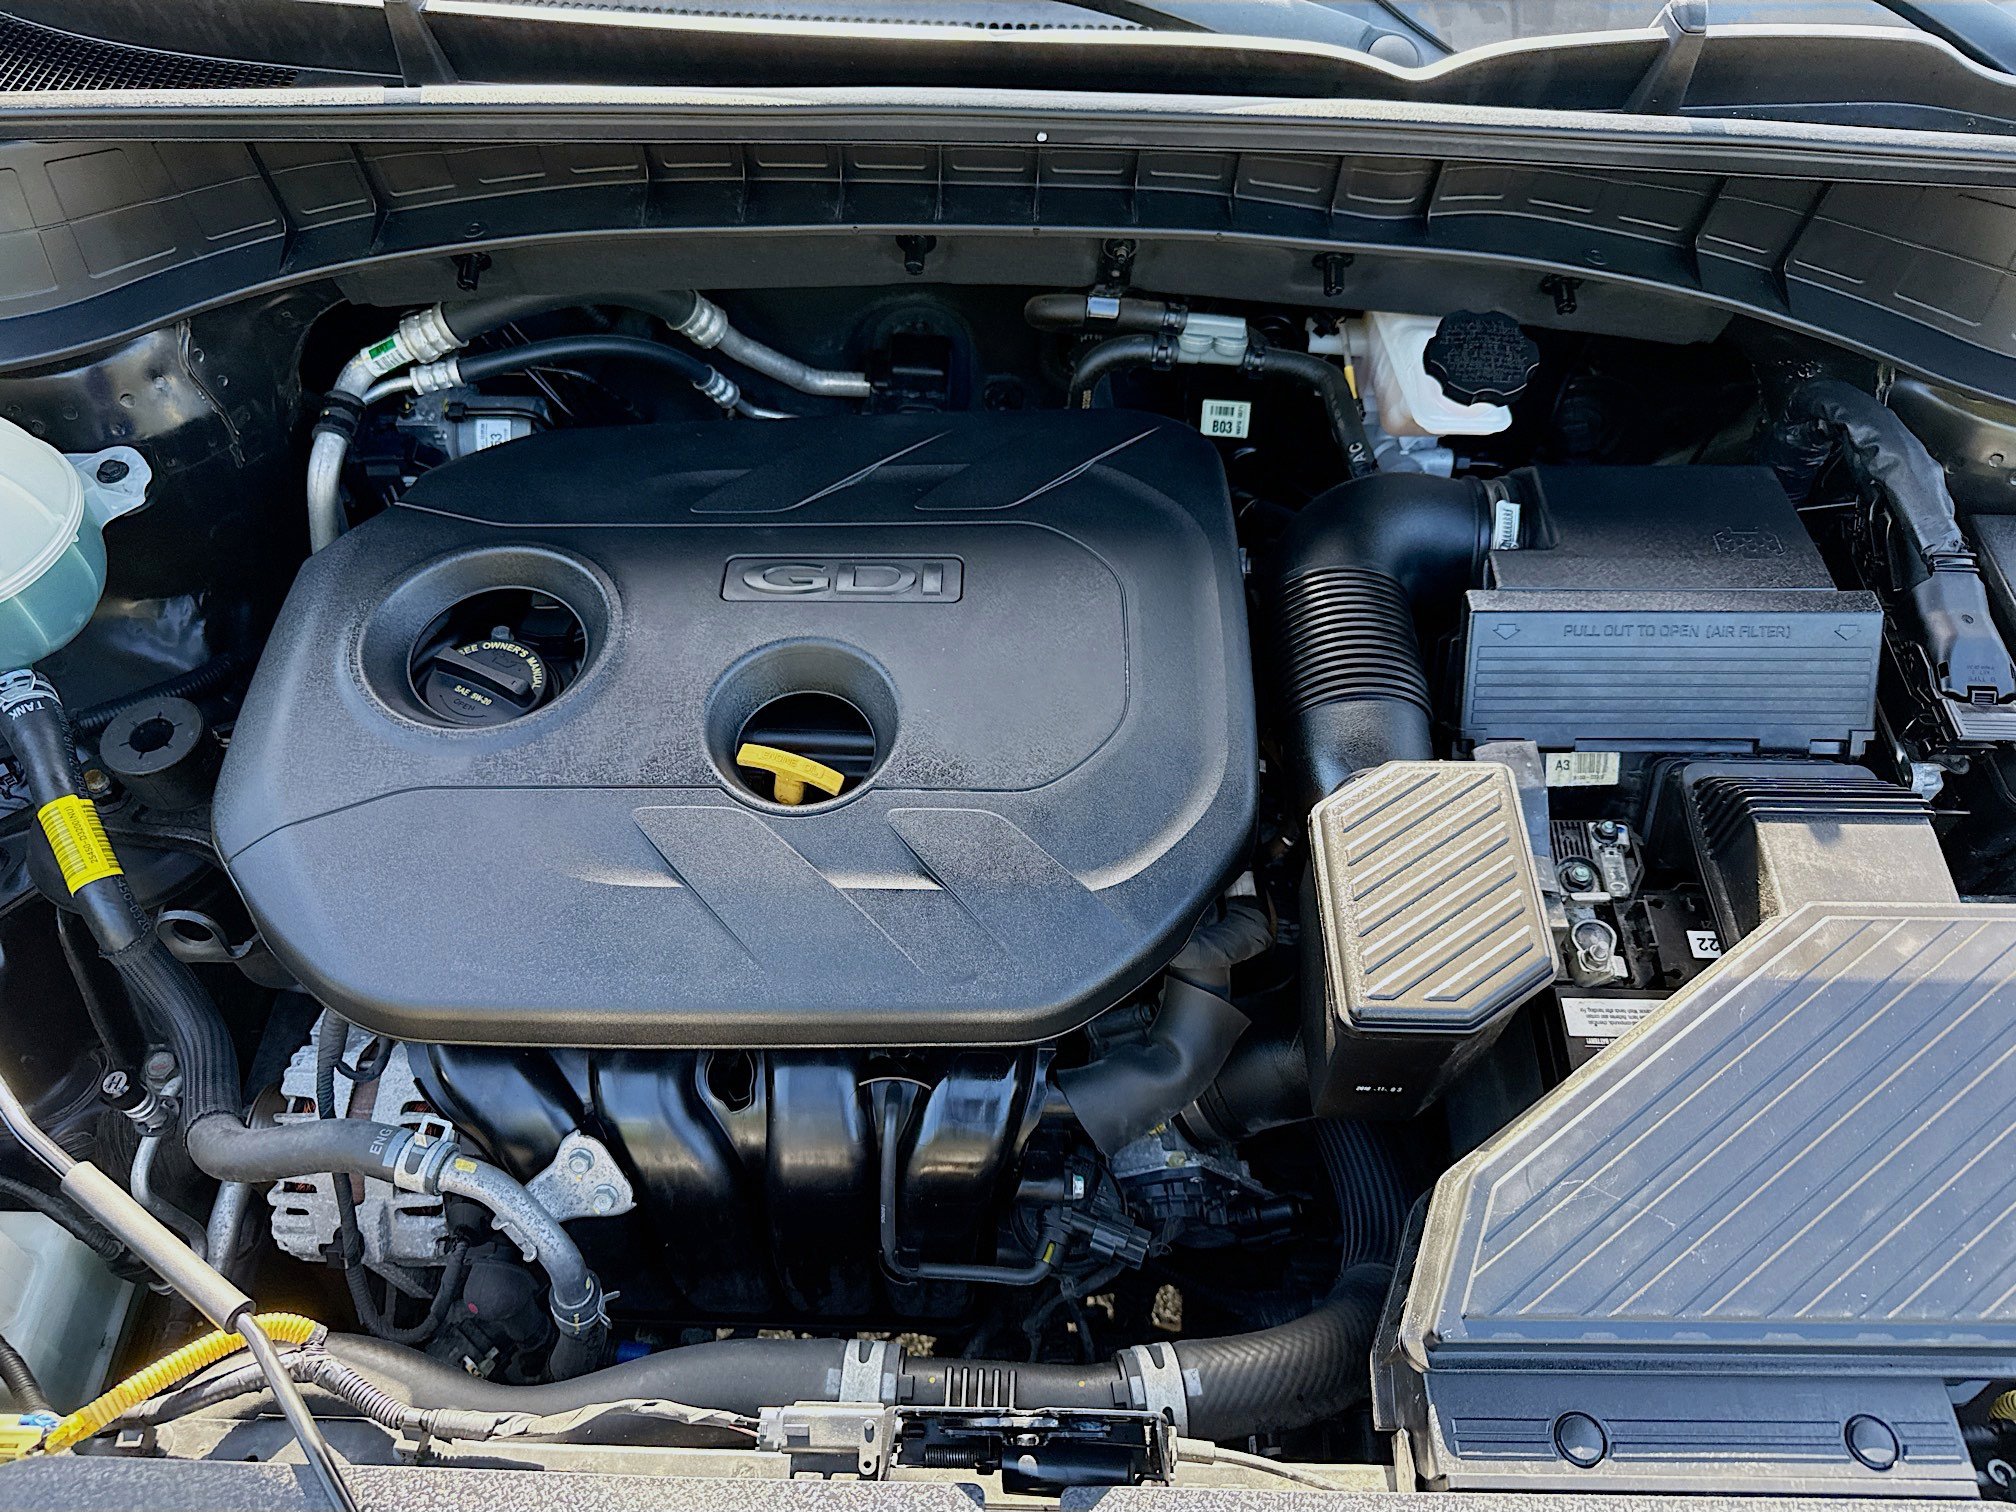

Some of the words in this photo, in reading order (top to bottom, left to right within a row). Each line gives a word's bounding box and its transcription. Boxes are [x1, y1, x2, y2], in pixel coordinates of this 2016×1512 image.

[1212, 420, 1233, 434] B03
[743, 562, 944, 596] GDI
[1563, 624, 1600, 637] PULL
[1603, 624, 1634, 637] OUT
[1637, 624, 1656, 637] TO
[1659, 624, 1700, 638] OPEN
[482, 641, 529, 658] OWNER'S
[525, 656, 543, 690] MANUAL
[454, 684, 471, 697] SAE
[470, 692, 493, 706] 5W-20
[8, 700, 45, 720] TANK
[453, 699, 476, 712] OPEN
[1555, 759, 1570, 771] A3
[107, 1075, 123, 1090] H
[369, 1127, 394, 1156] ENG
